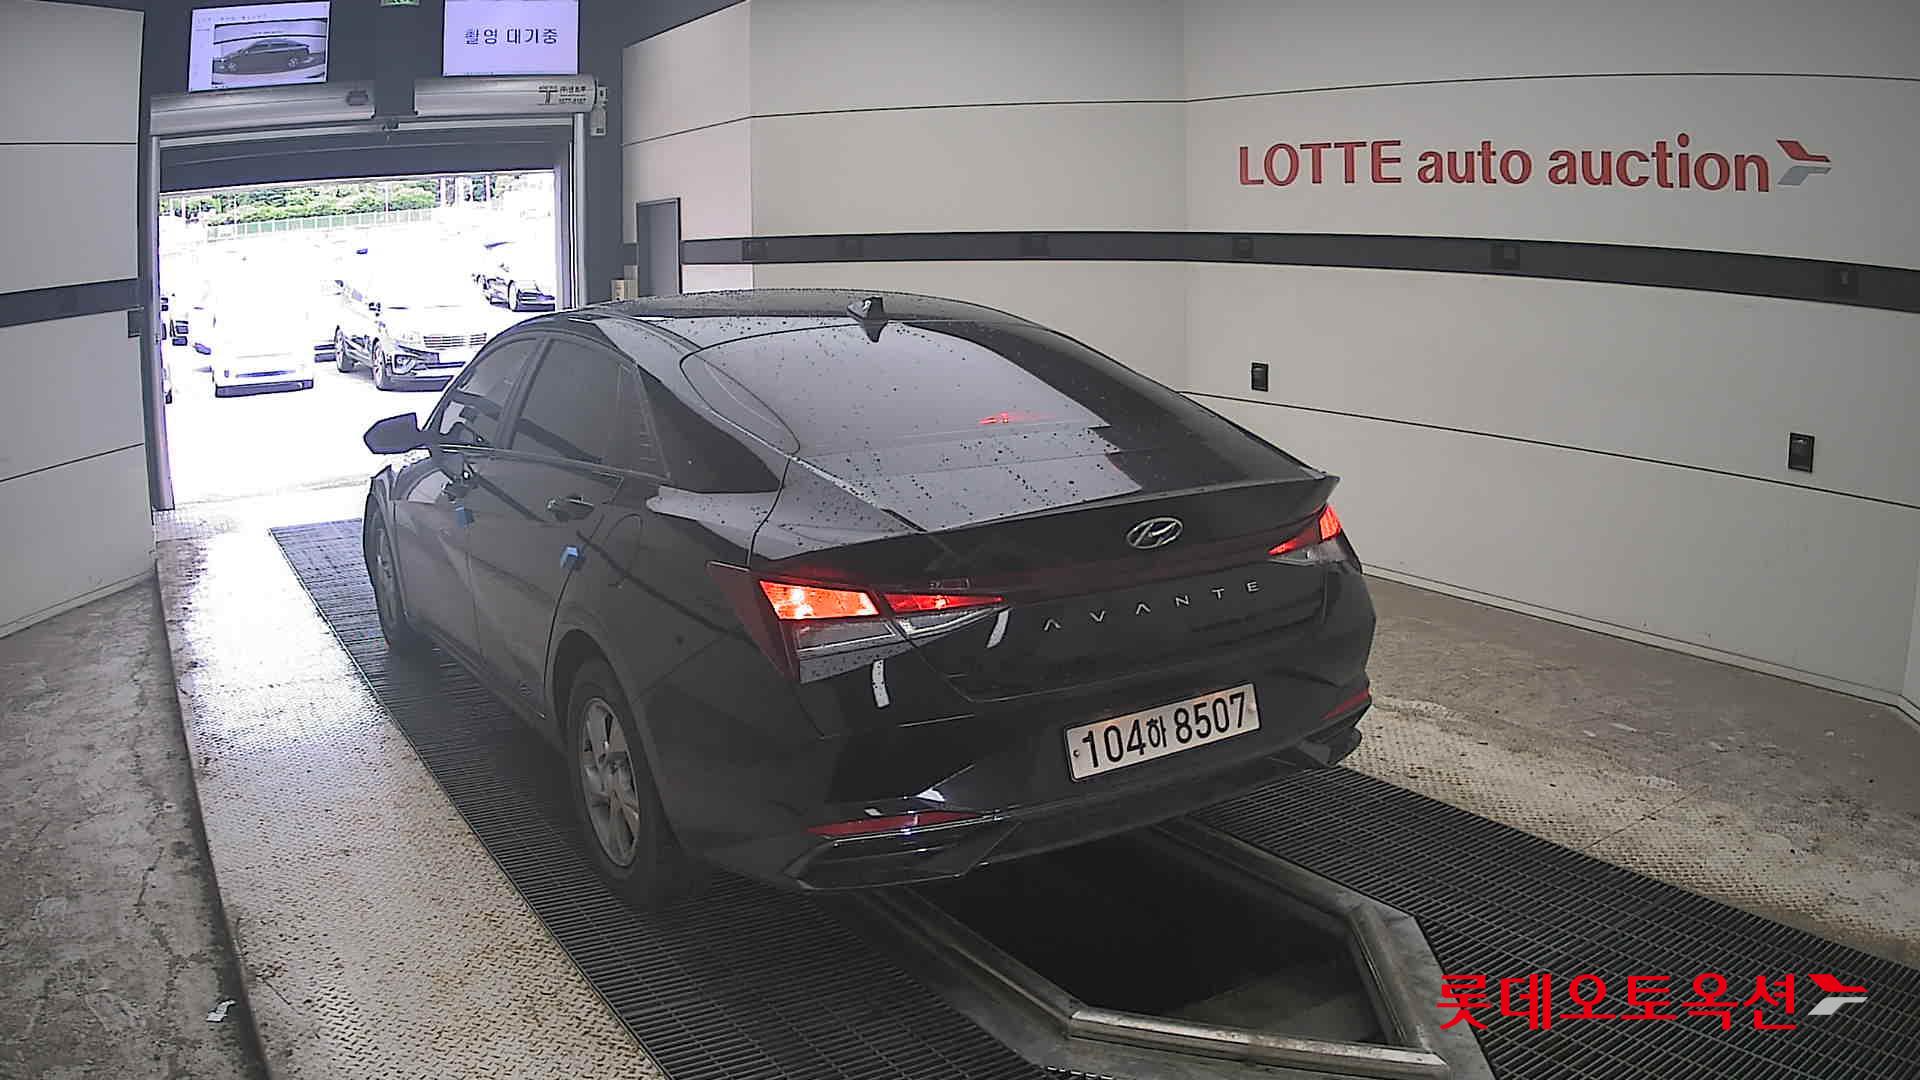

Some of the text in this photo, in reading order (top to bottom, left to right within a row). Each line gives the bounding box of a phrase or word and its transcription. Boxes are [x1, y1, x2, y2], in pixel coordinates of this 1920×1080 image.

[506, 28, 559, 45] 대기중
[1239, 133, 1769, 192] LOTTE auto auction
[1043, 581, 1259, 631] AVANTE
[1174, 692, 1246, 744] 8507
